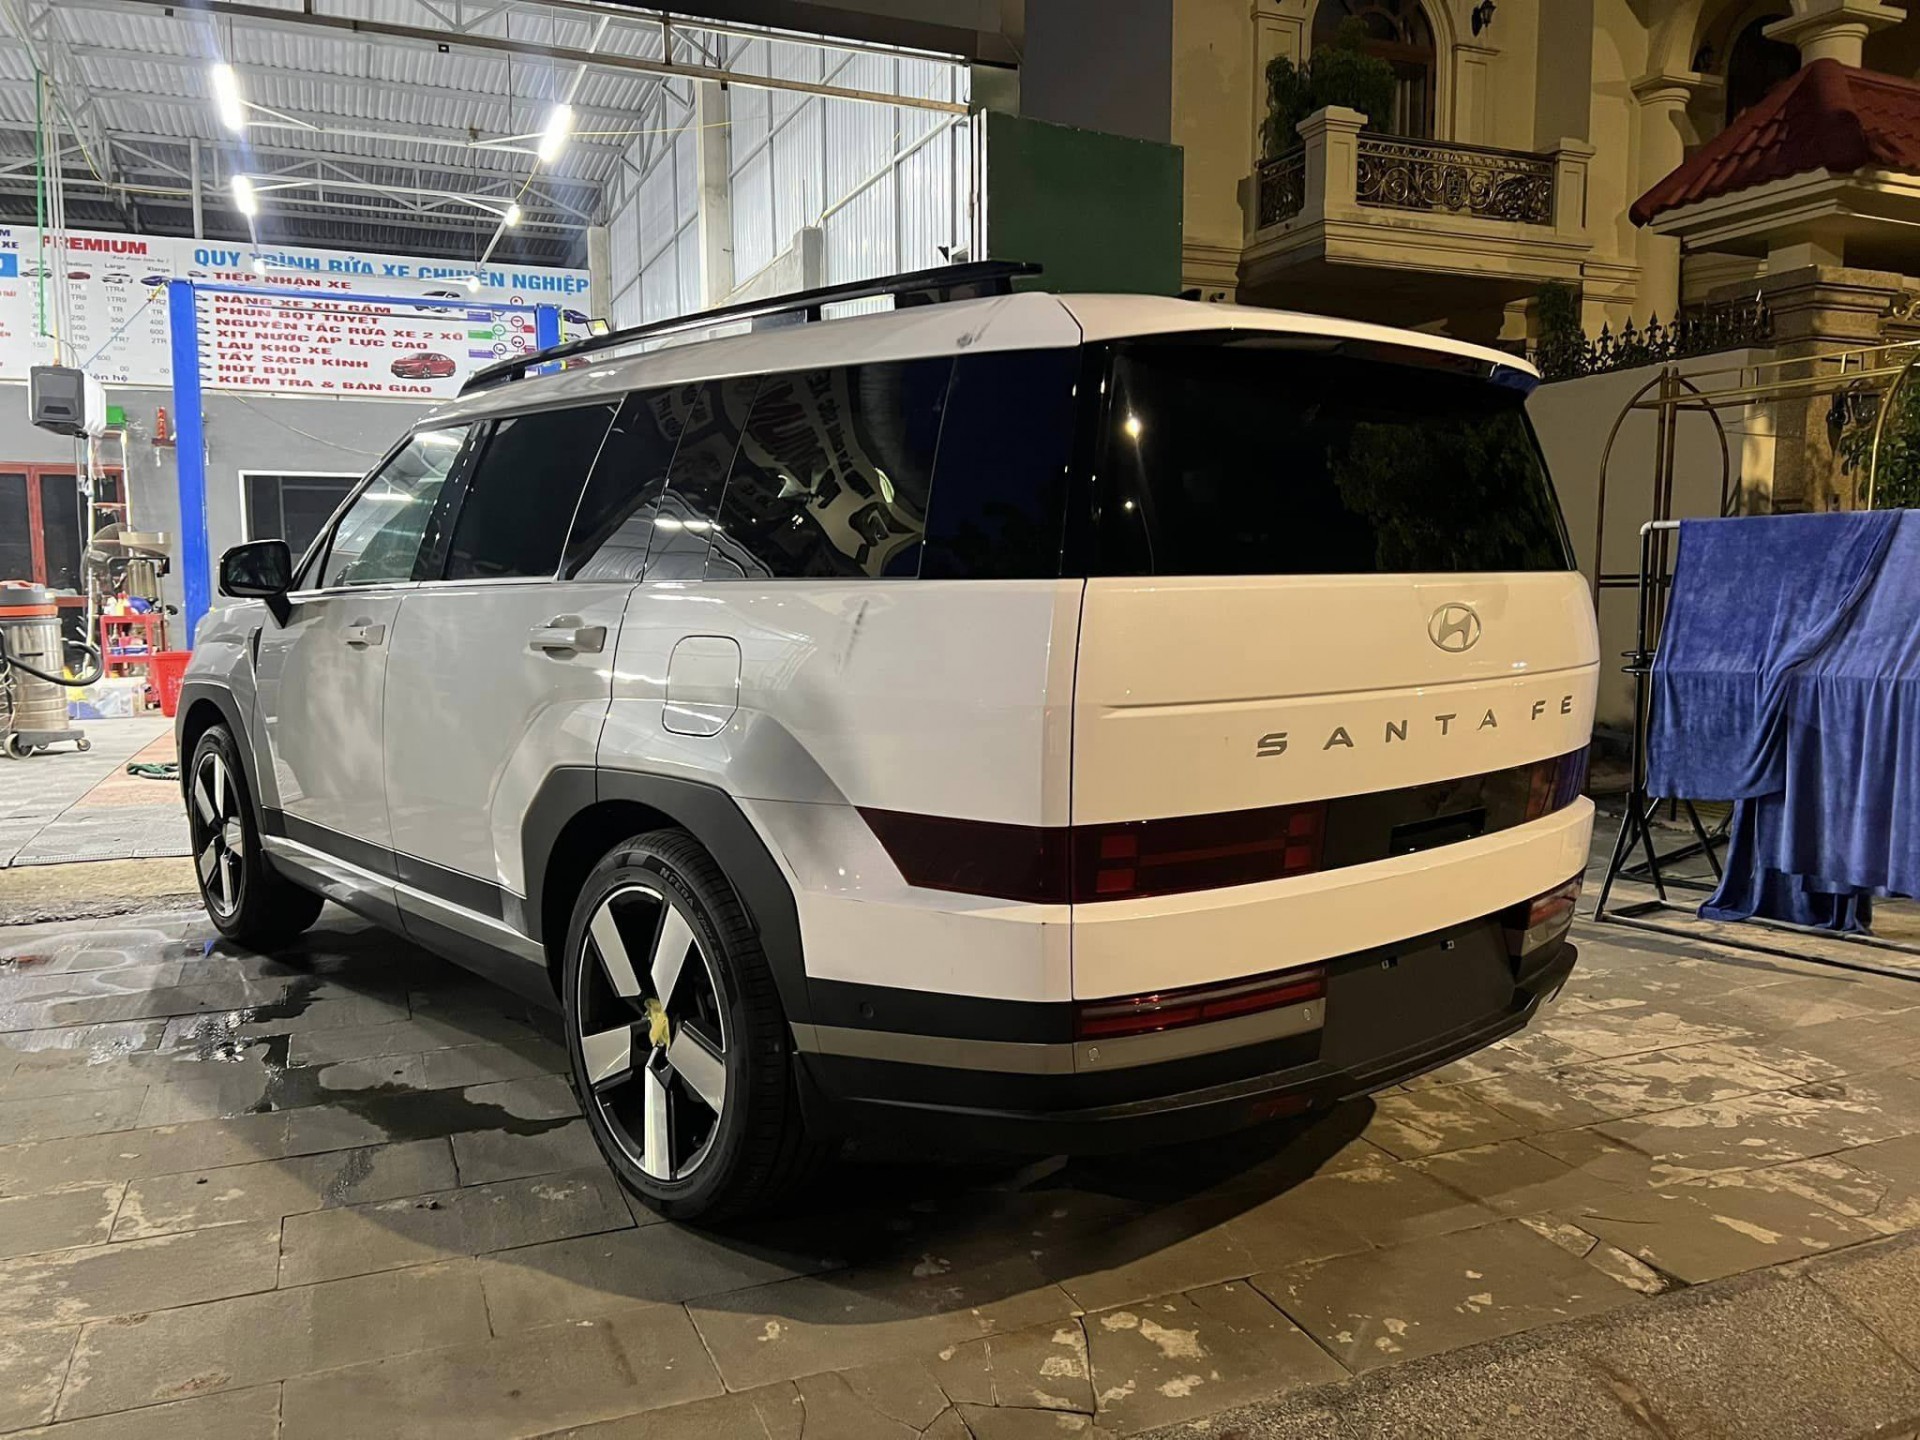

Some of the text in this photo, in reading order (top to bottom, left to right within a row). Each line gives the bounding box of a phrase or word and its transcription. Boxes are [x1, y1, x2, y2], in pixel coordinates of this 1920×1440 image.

[42, 235, 147, 255] PREMIUM
[194, 249, 241, 267] QUY
[382, 264, 410, 277] XE
[512, 273, 589, 295] NGHIỆP
[328, 281, 353, 289] XE
[215, 307, 271, 318] PHUN
[393, 330, 416, 339] XE
[217, 341, 254, 350] LAU
[308, 346, 332, 355] XE
[392, 341, 428, 349] CAO
[322, 358, 368, 368] KÍNH
[278, 379, 314, 388] TRA
[389, 385, 432, 393] GIAO
[1256, 695, 1573, 758] SANTA FE
